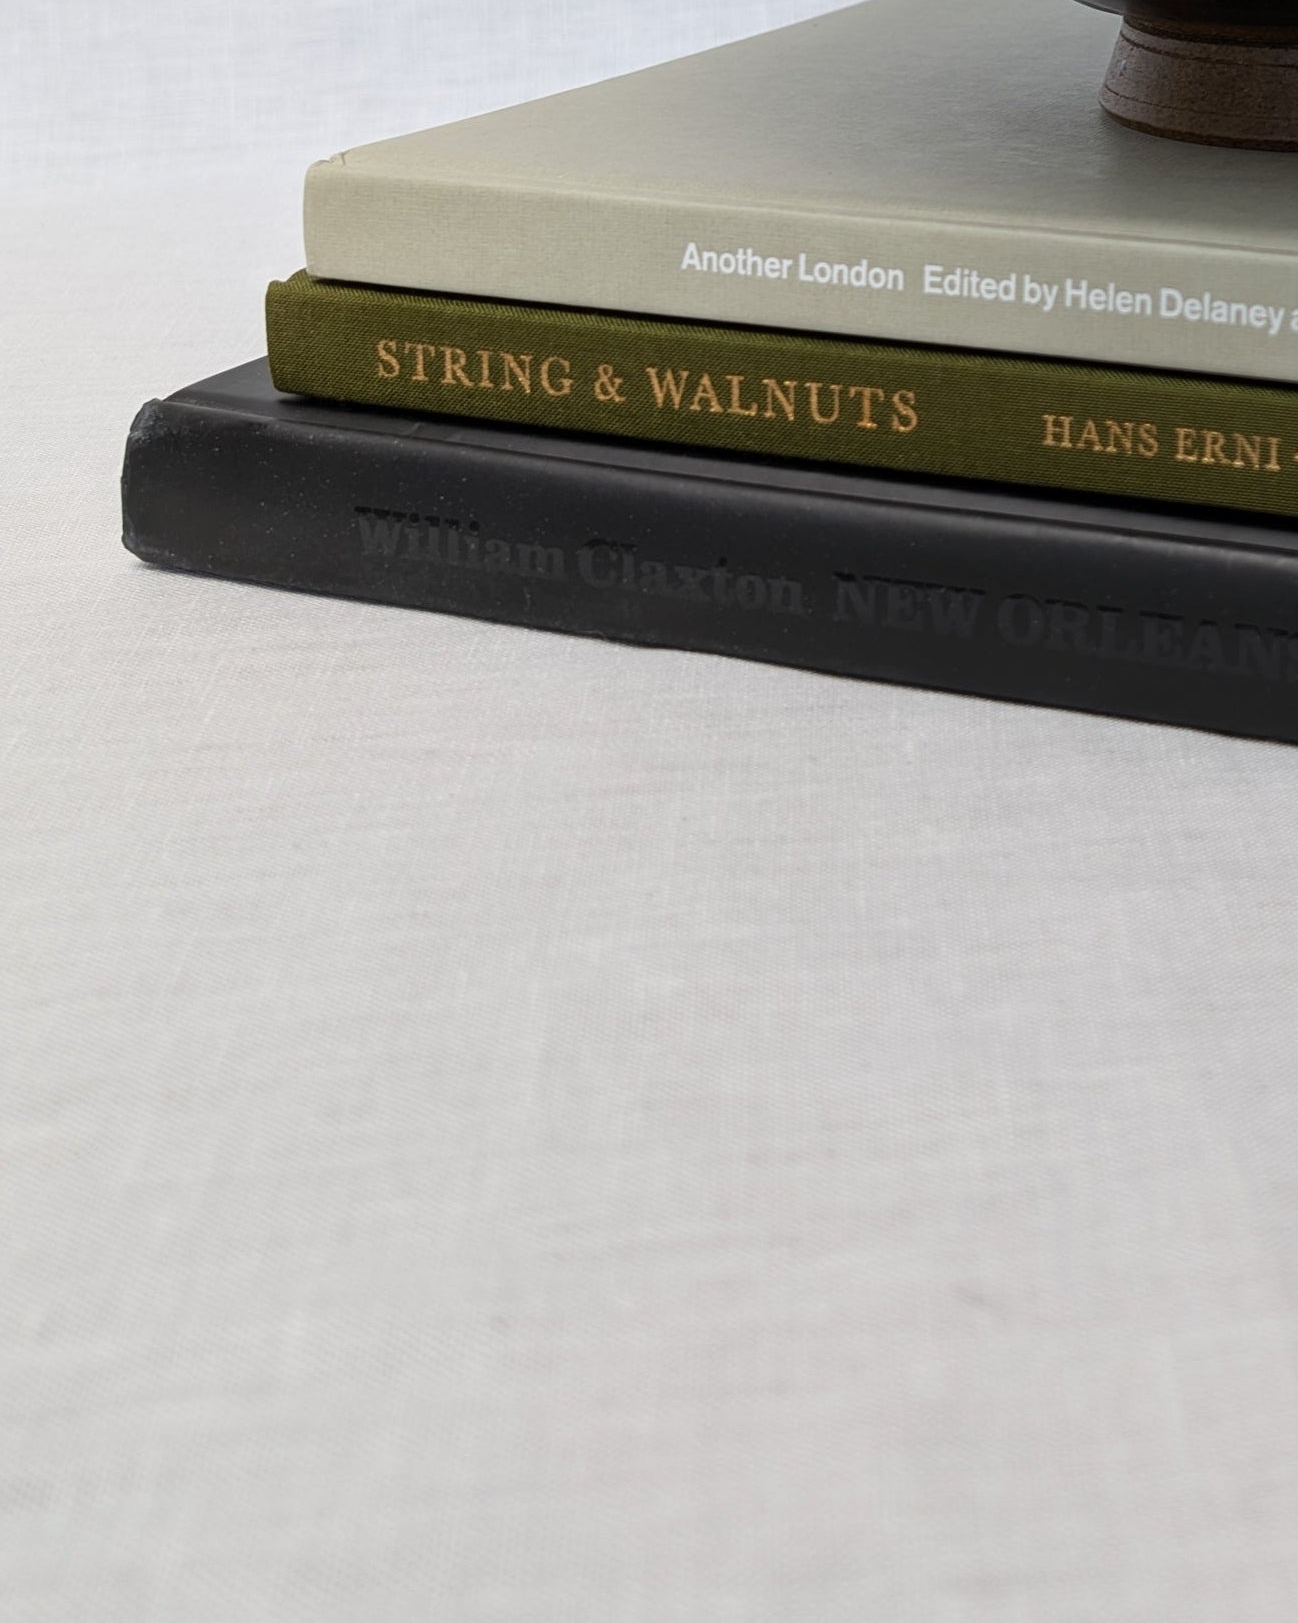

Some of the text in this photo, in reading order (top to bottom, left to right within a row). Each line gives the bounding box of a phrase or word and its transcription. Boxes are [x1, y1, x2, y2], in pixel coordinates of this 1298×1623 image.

[681, 242, 793, 279] Another
[799, 253, 904, 291] London
[923, 265, 1016, 302] Edited
[1024, 275, 1058, 312] by
[1065, 280, 1152, 316] Helen
[1160, 286, 1284, 335] Delaney
[375, 339, 575, 398] STRING
[593, 363, 627, 403] &
[645, 366, 919, 434] WALNUTS
[1042, 414, 1159, 458] HANS
[1175, 427, 1282, 472] ERNI
[354, 506, 566, 580] William
[577, 537, 802, 617] Claxton
[834, 572, 986, 641] NEW
